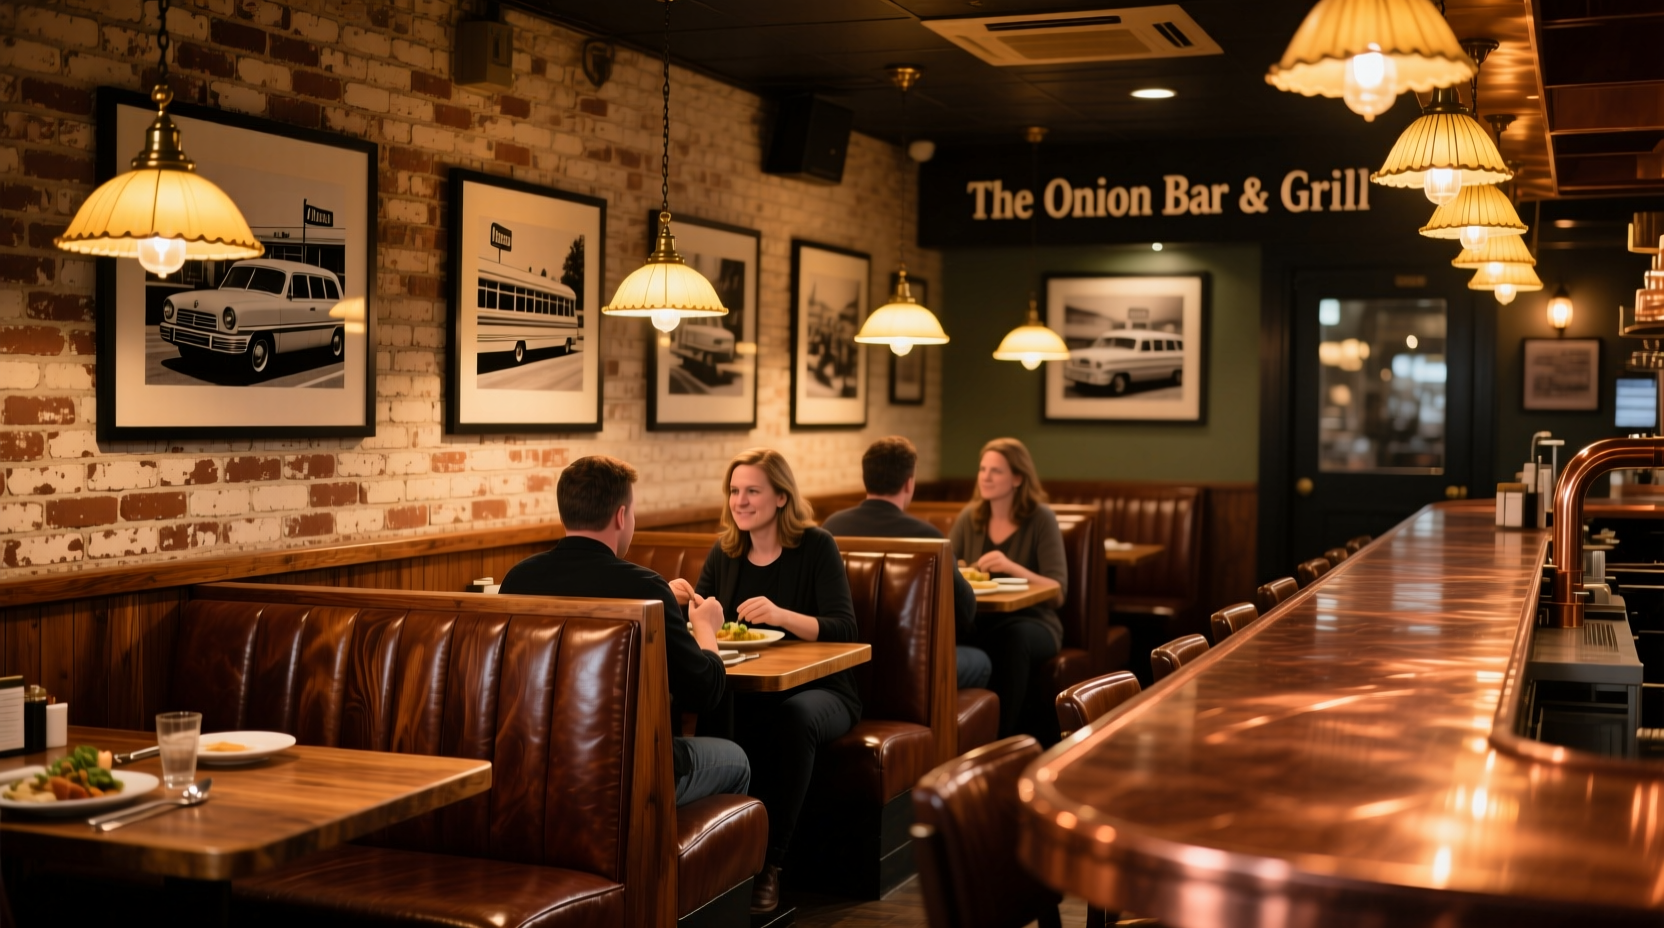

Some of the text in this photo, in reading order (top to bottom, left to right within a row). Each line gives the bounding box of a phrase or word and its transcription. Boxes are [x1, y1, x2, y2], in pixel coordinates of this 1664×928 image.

[967, 168, 1371, 220] The Onion Bar & Grill
